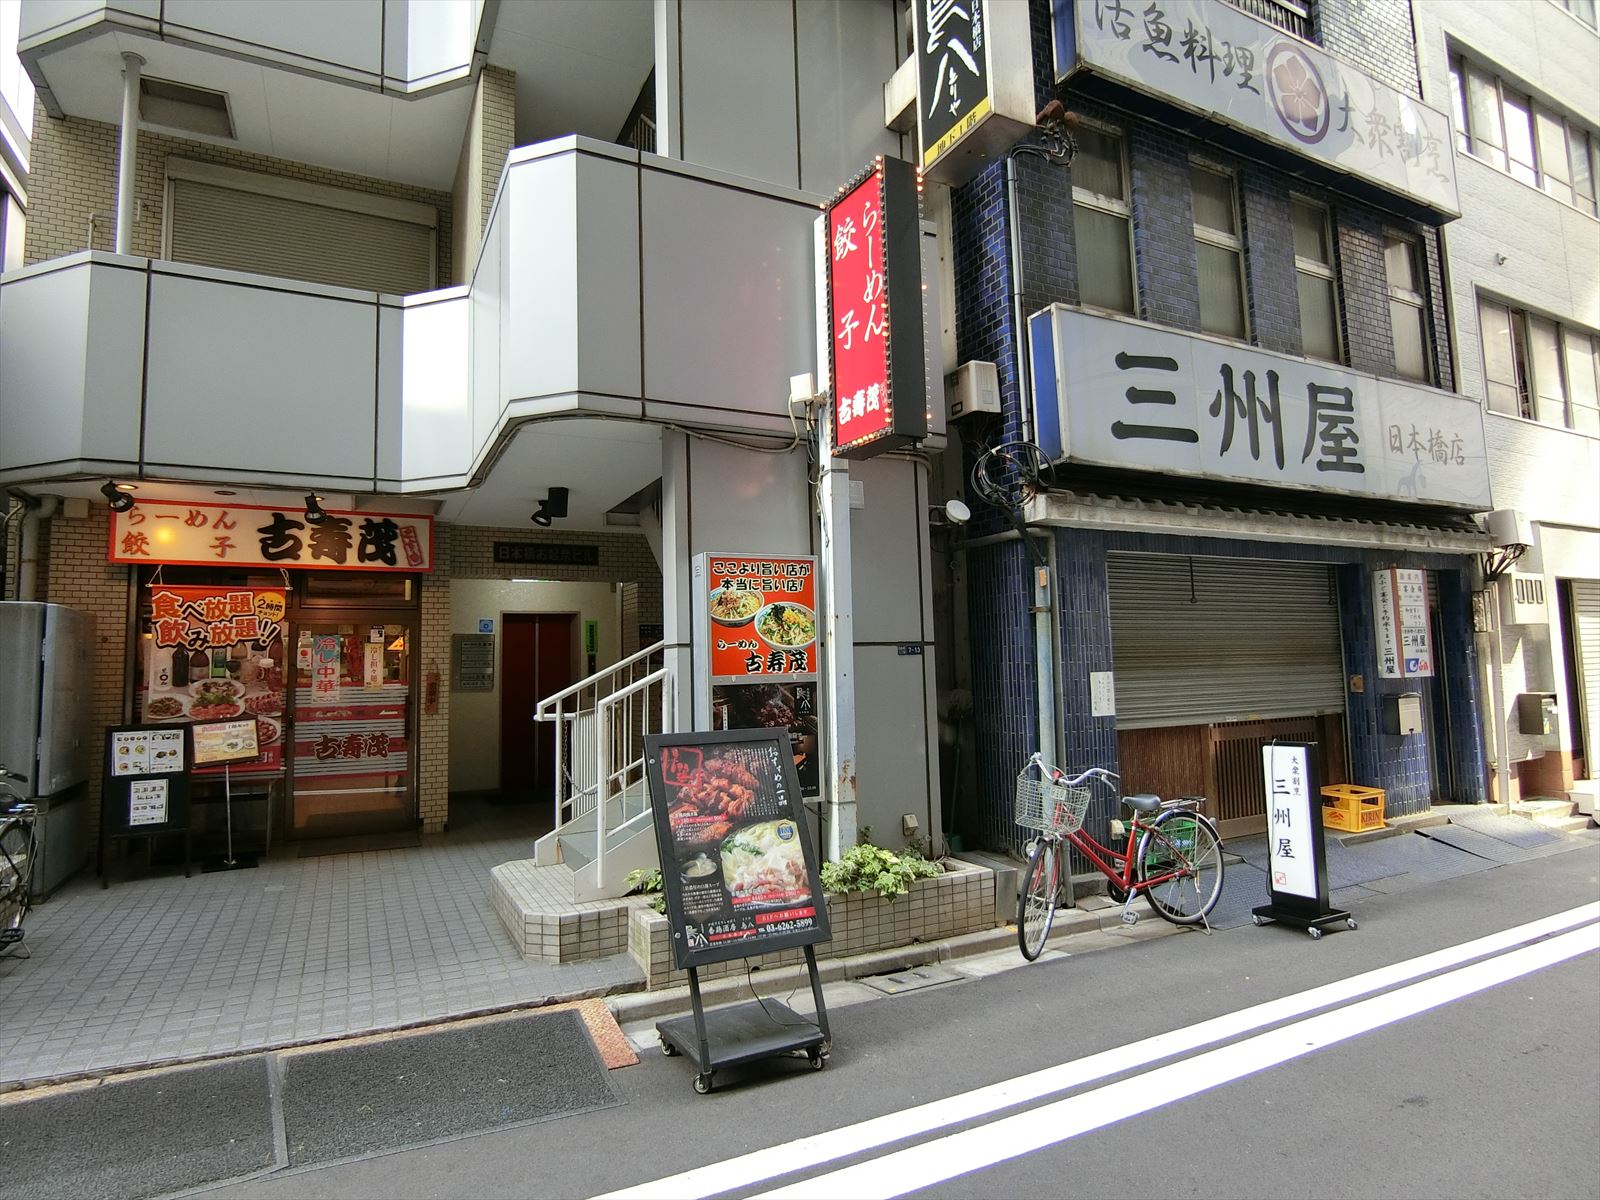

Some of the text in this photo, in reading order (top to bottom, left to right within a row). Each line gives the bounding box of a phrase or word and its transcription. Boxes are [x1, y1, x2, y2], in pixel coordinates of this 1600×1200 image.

[834, 216, 859, 350] 餃子
[862, 200, 885, 342] らーめん
[838, 381, 880, 427] 古寿茂
[1111, 351, 1365, 473] 三州屋
[1388, 423, 1466, 468] 日本橋店
[128, 505, 237, 531] らーめん
[121, 531, 237, 559] 餃子
[257, 512, 399, 567] 古寿茂
[713, 562, 810, 576] ここより旨い店が
[721, 578, 804, 592] 本当に旨い店!
[152, 591, 253, 622] 食べ放題
[717, 640, 758, 650] らーめん
[1403, 635, 1427, 648] 三州屋
[316, 637, 336, 693] 冷し中華
[744, 651, 808, 674] 古寿茂
[1384, 647, 1396, 675] 三州屋
[313, 732, 390, 760] 古寿茂
[768, 746, 788, 807] おすすめの一品
[1273, 779, 1296, 859] 三州屋
[766, 919, 813, 933] 03-6262-5899
